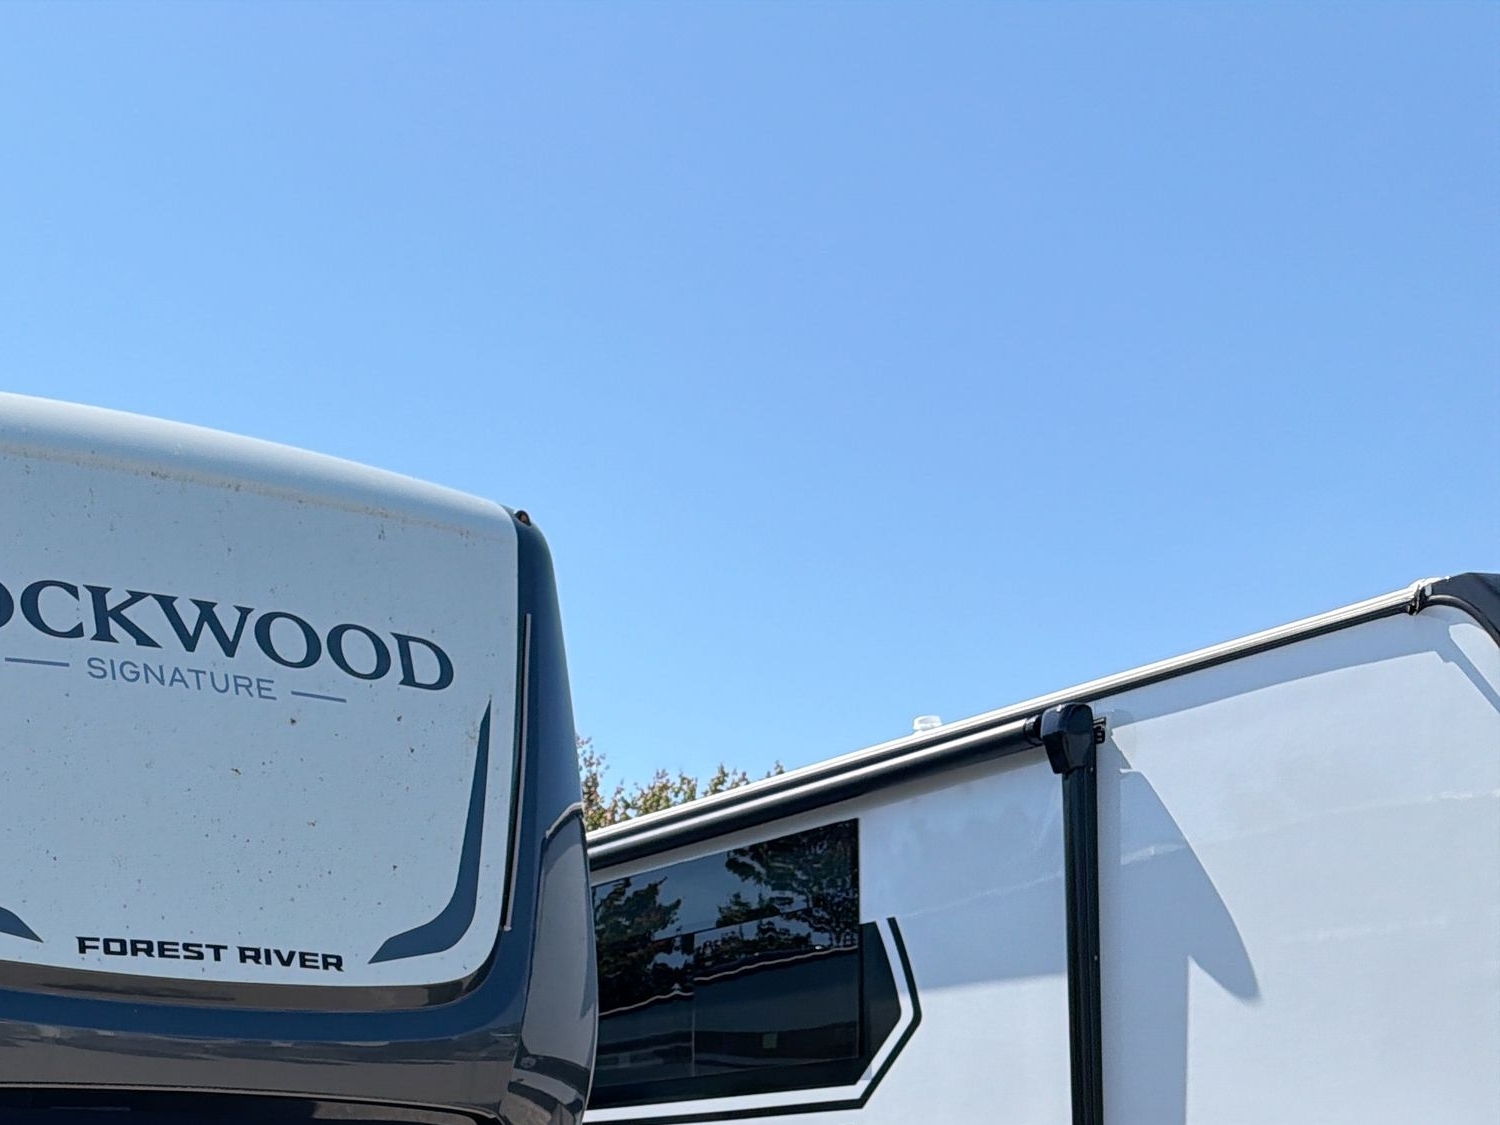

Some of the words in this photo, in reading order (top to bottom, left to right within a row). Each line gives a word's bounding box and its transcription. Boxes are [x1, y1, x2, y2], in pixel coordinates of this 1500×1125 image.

[86, 656, 278, 702] SIGNATURE
[75, 936, 229, 963] FOREST
[236, 945, 345, 972] RIVER
